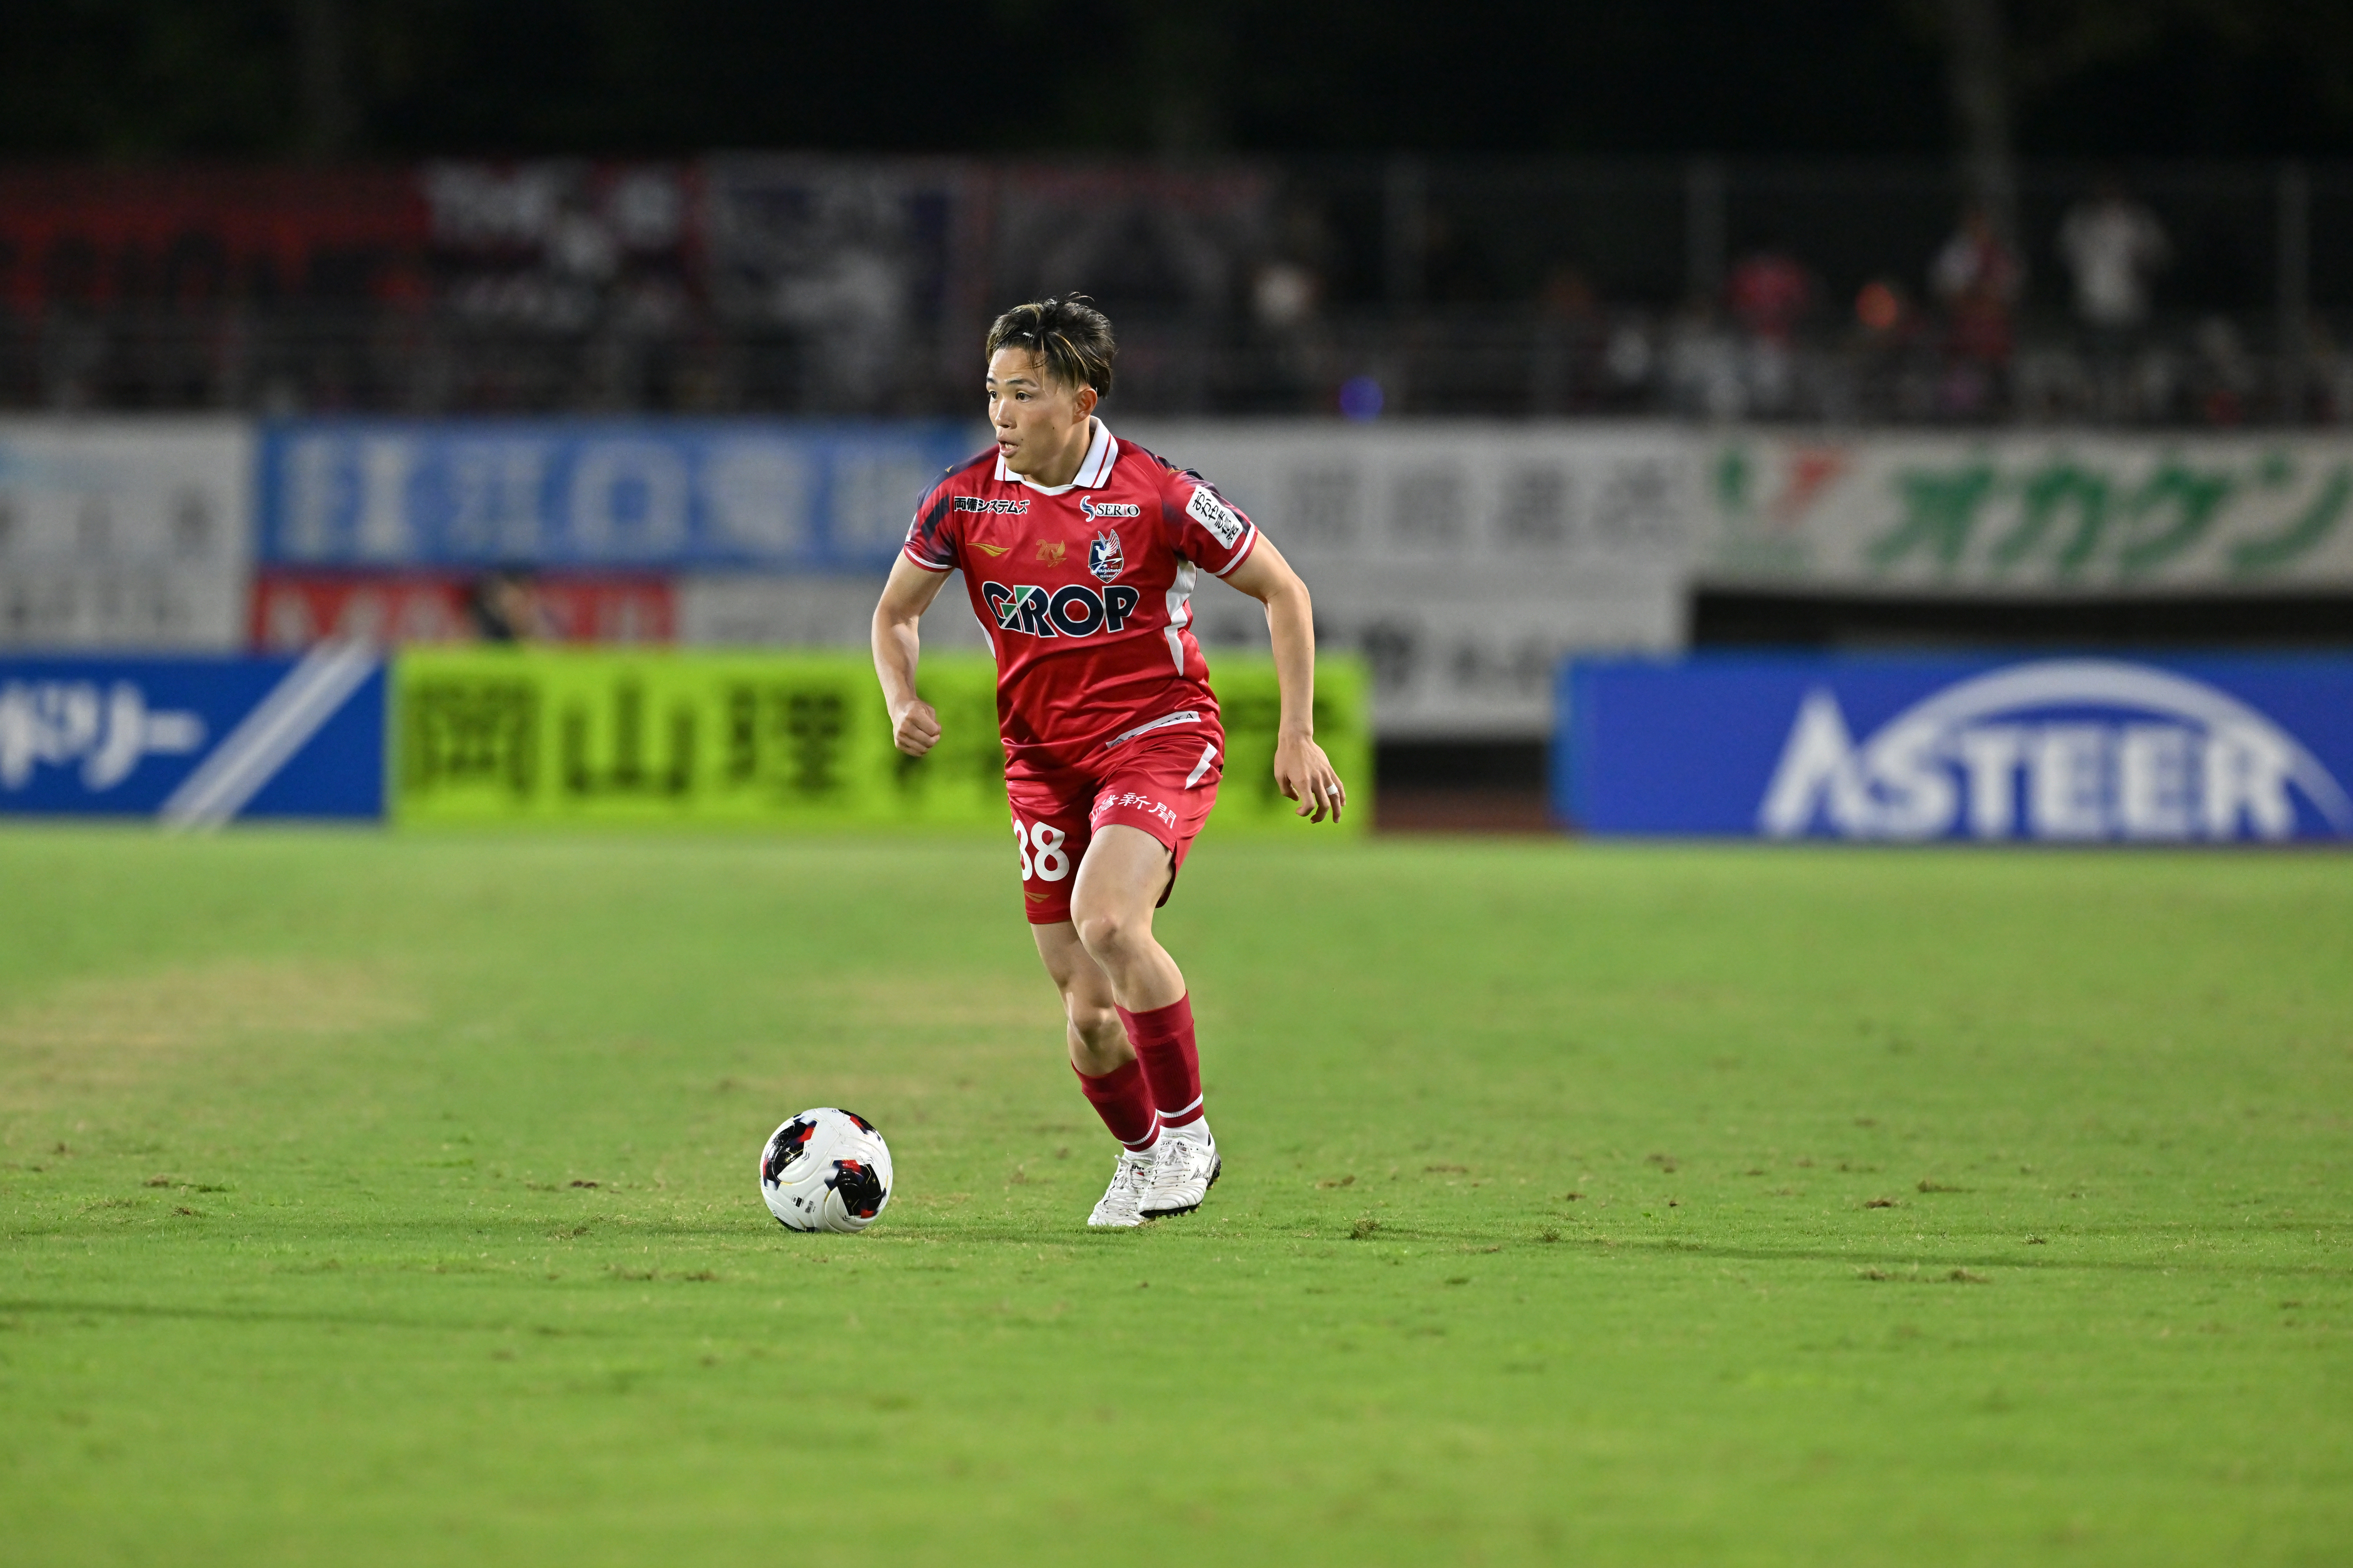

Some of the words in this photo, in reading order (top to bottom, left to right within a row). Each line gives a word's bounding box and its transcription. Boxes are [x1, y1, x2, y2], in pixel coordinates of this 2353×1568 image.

[954, 497, 1029, 514] 両備システムズ
[1096, 504, 1139, 516] SERIO
[981, 581, 1140, 638] GROP
[1760, 677, 2296, 837] ASTEER
